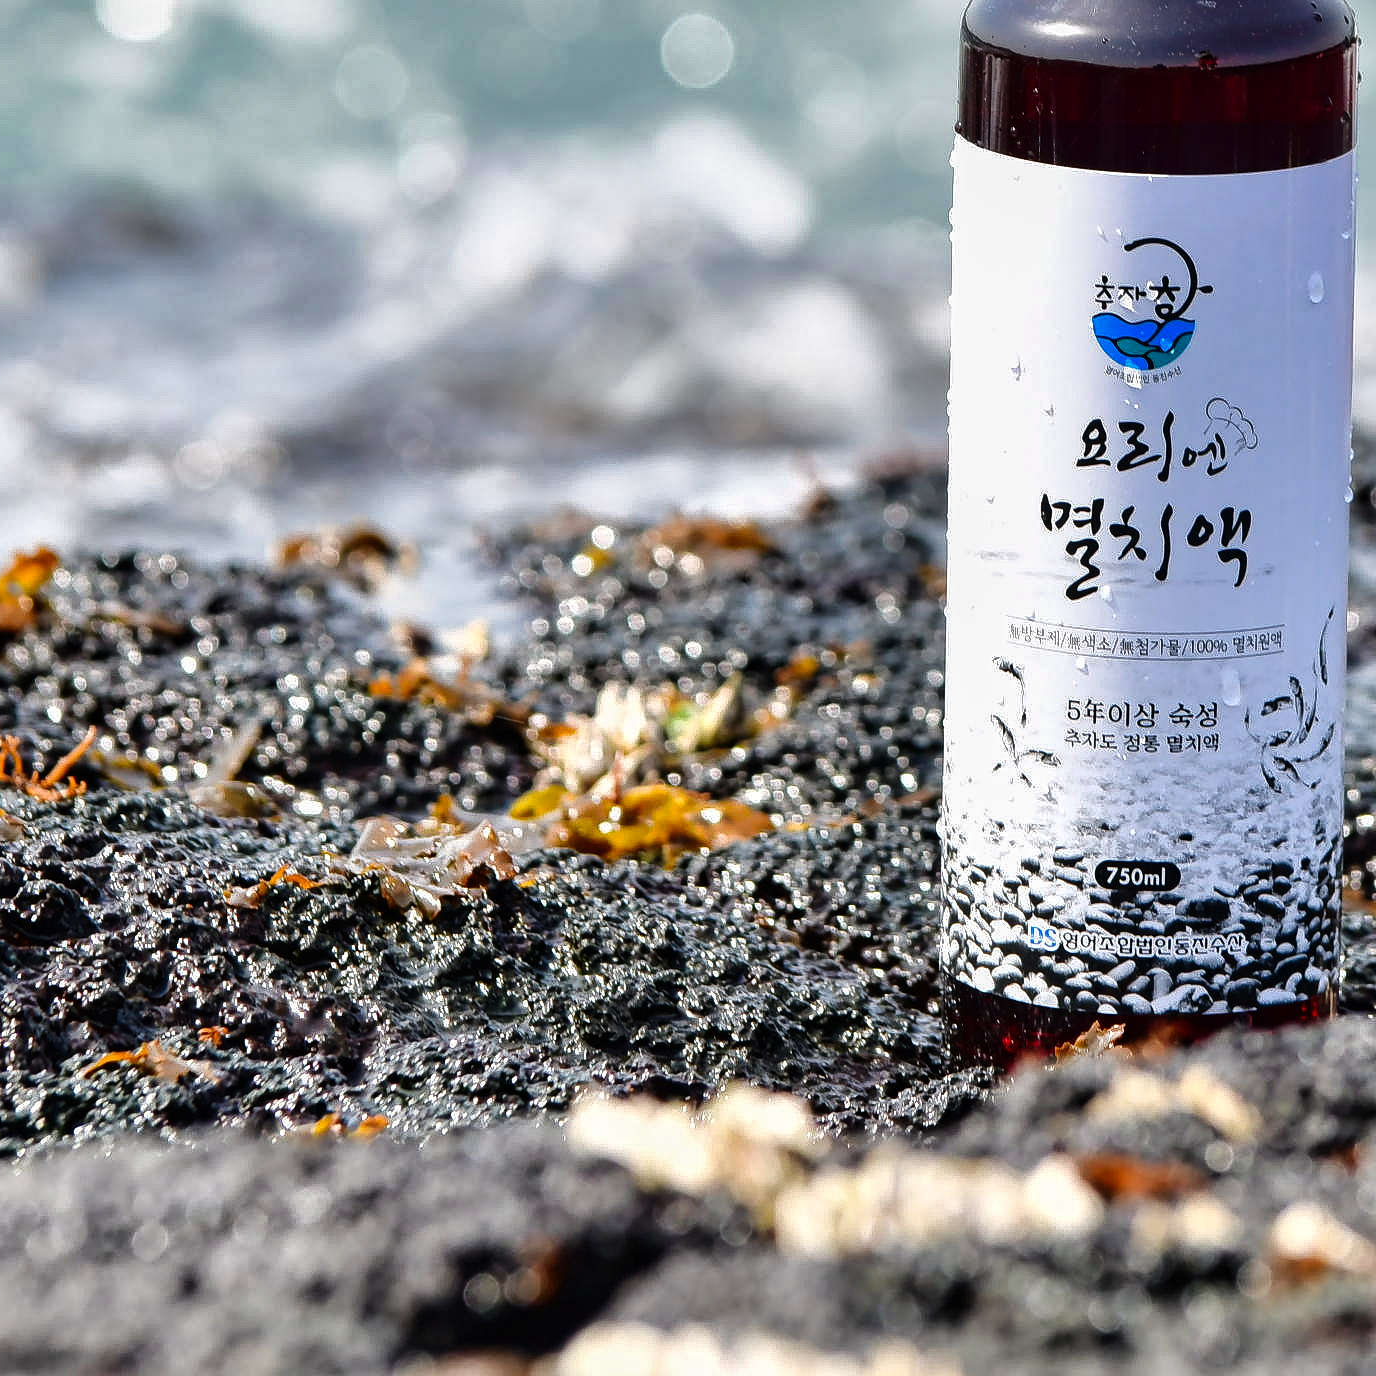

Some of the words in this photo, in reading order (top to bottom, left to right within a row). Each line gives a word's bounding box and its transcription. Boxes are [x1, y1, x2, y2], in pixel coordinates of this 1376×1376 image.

[1075, 410, 1228, 482] 요리엔
[1040, 493, 1252, 601] 멸치액
[1232, 631, 1283, 654] 멸치원액
[1067, 699, 1160, 729] 5年이상
[1169, 702, 1219, 729] 숙성
[1064, 729, 1118, 751] 추자도
[1124, 733, 1160, 753] 정통
[1166, 735, 1220, 753] 멸치액
[1106, 866, 1167, 887] 750ml
[1030, 926, 1058, 948] DS
